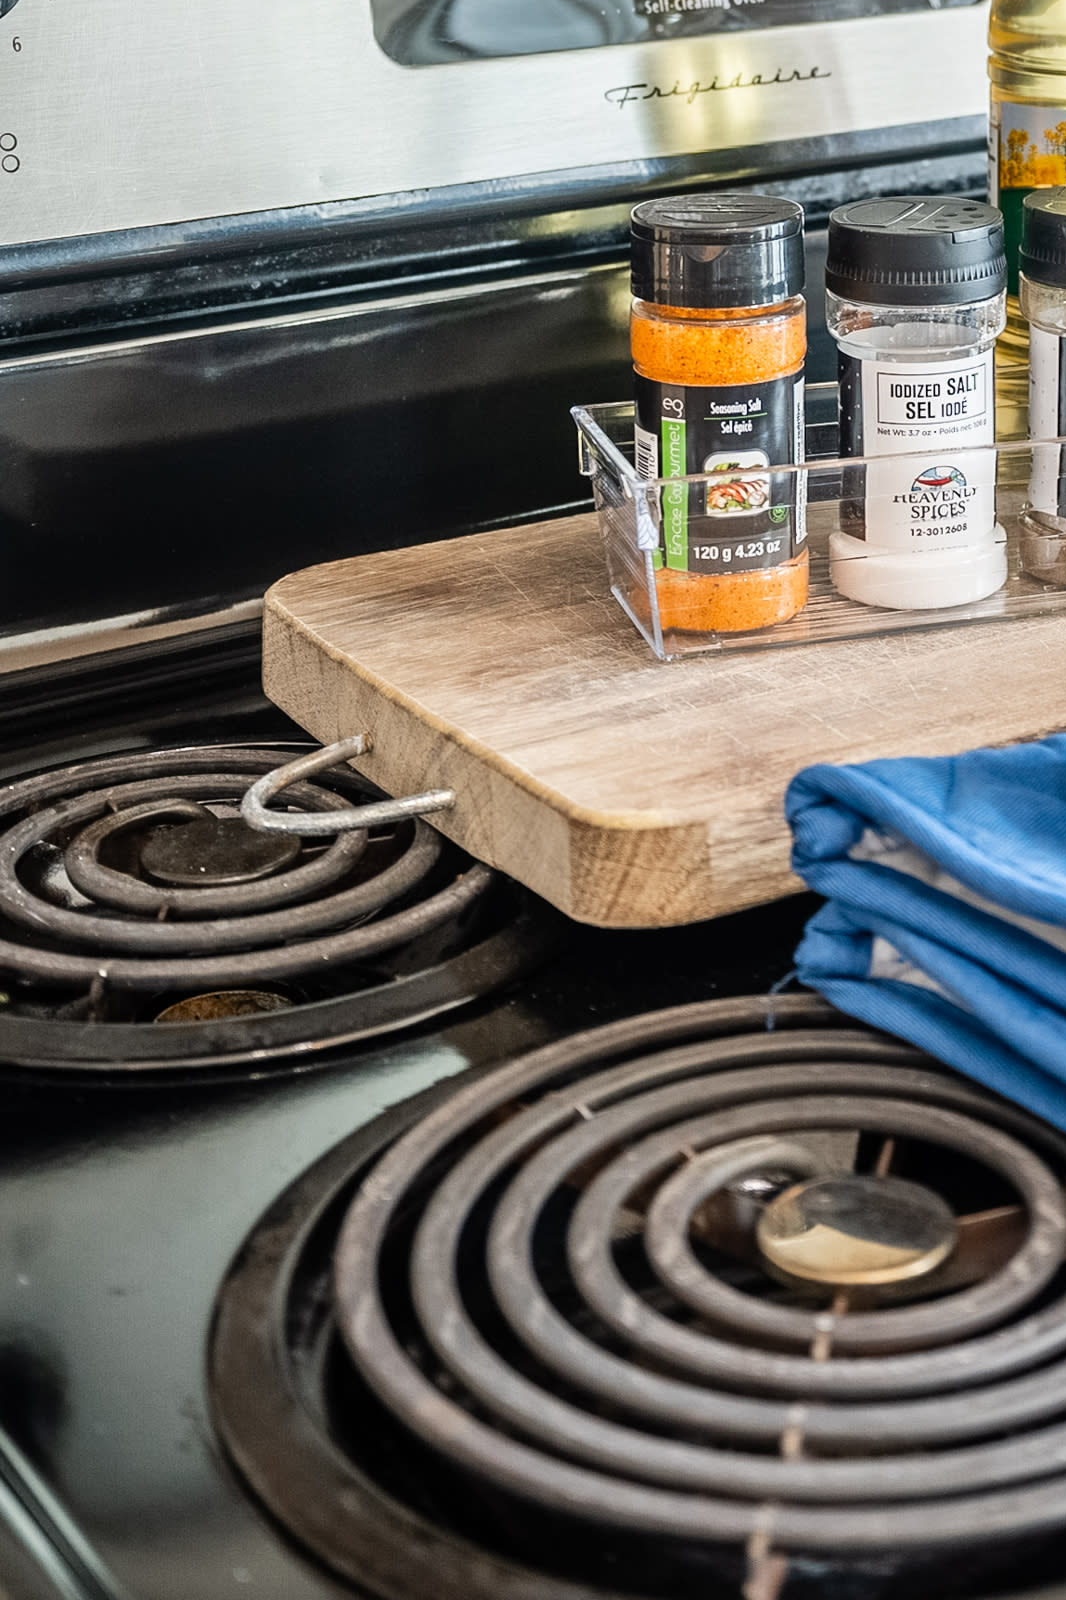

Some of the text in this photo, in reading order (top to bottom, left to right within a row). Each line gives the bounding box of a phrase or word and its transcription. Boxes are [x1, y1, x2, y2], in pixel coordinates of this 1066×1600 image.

[12, 36, 22, 52] 6
[604, 65, 832, 110] Frigidaire
[890, 372, 980, 399] IODIZED SALT
[710, 398, 762, 416] Seasoning Salt
[905, 396, 968, 420] SEL IODÉ
[720, 419, 753, 436] Sel épicé
[876, 427, 892, 437] Net
[908, 428, 920, 437] 3.7
[921, 429, 932, 437] oz
[939, 423, 960, 436] Poids
[910, 499, 967, 520] SPICES
[909, 521, 969, 537] 12-3012608
[693, 539, 782, 563] 120 g 4.23 oz
